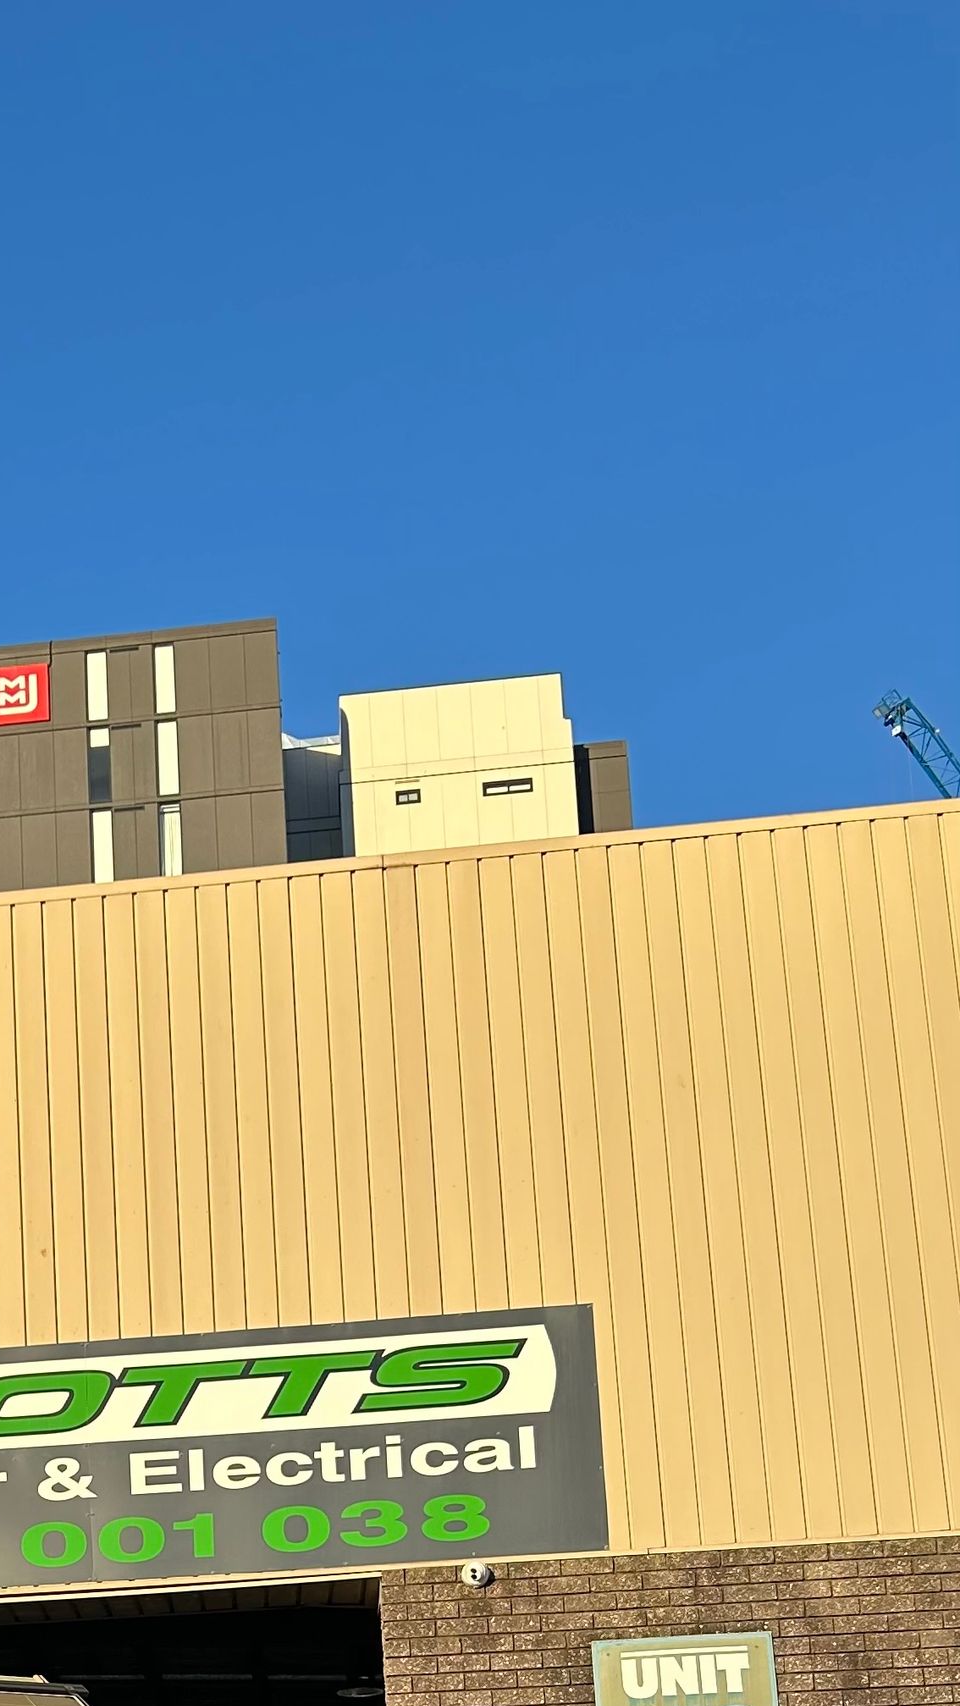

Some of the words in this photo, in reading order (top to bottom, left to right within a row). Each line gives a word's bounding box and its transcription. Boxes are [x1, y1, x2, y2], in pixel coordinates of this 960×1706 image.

[37, 1457, 98, 1502] &
[129, 1425, 536, 1495] Electrical
[21, 1512, 215, 1569] 001
[262, 1494, 491, 1553] 038
[621, 1652, 750, 1700] UNIT
